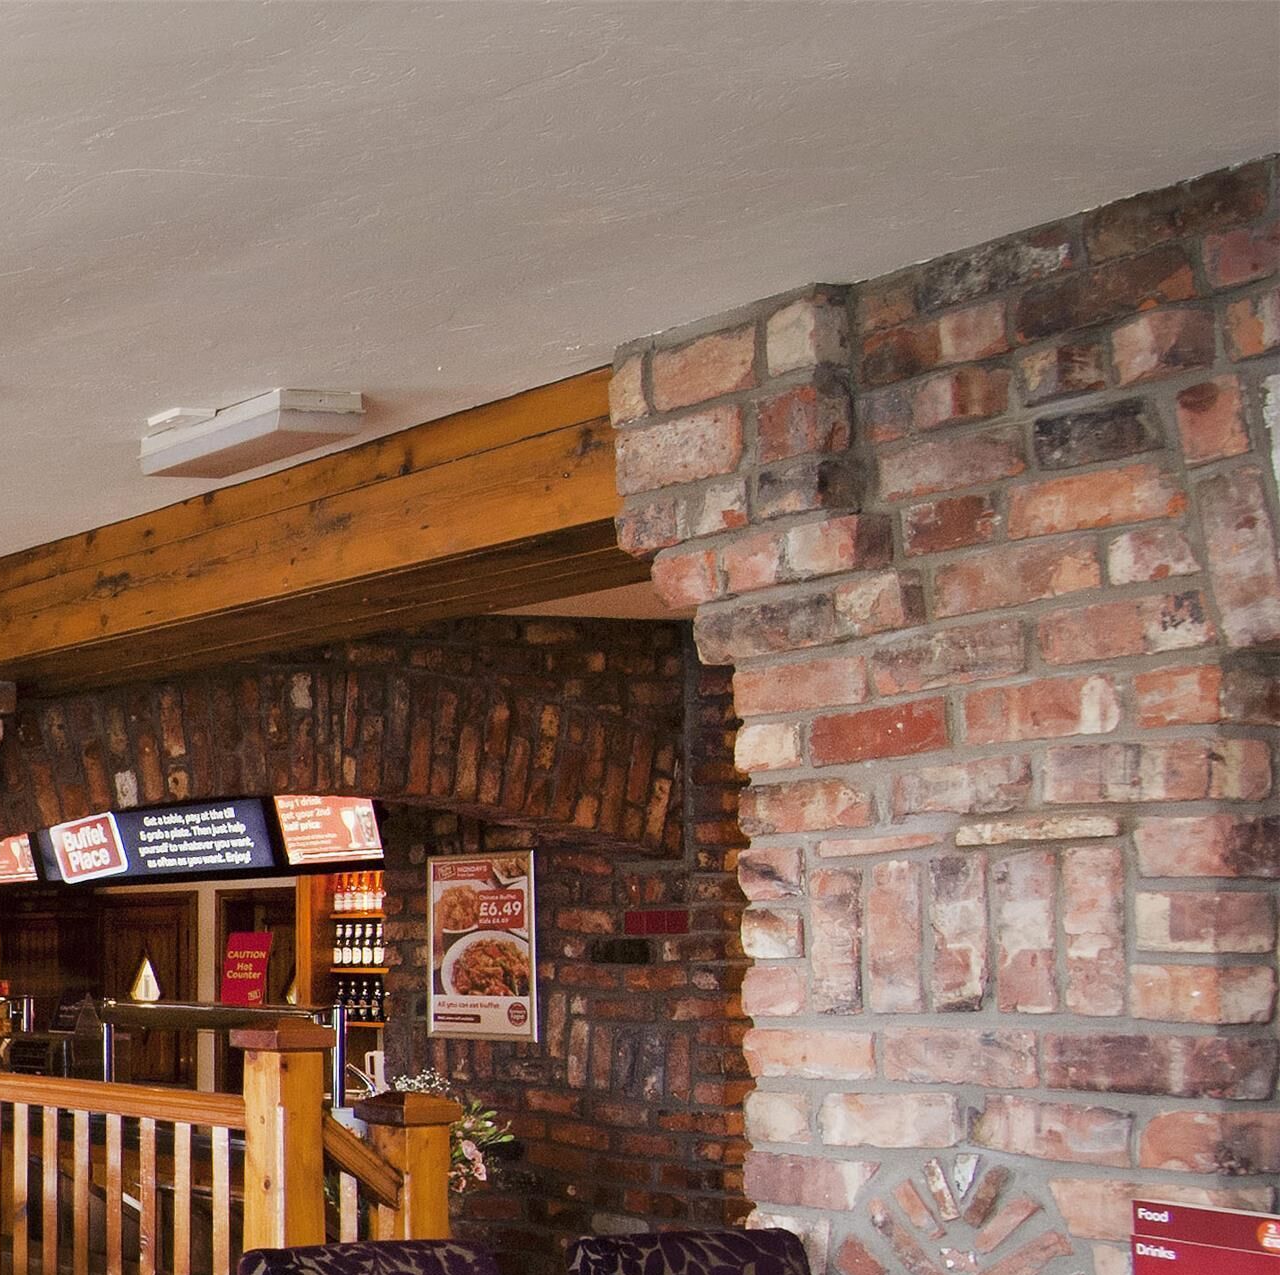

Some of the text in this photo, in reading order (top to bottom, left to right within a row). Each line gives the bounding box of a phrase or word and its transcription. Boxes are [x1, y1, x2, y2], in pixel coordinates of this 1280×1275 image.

[144, 816, 158, 826] Get
[185, 814, 201, 824] pay
[209, 809, 223, 820] the
[223, 807, 235, 819] till
[62, 823, 108, 852] Buffet
[146, 829, 164, 842] grab
[191, 825, 212, 836] Then
[212, 823, 228, 836] just
[227, 821, 246, 834] help
[138, 842, 169, 857] yourself
[169, 843, 178, 852] to
[178, 841, 214, 852] whatever
[214, 840, 230, 851] you
[68, 848, 111, 873] Place
[147, 859, 157, 868] as
[157, 856, 177, 867] often
[177, 857, 187, 866] as
[187, 856, 203, 868] you
[479, 901, 522, 916] £6.49
[227, 951, 267, 959] CAUTION
[226, 970, 262, 979] Counter
[237, 962, 253, 971] Hot
[1137, 1207, 1169, 1223] Food
[1136, 1243, 1176, 1260] Drinks
